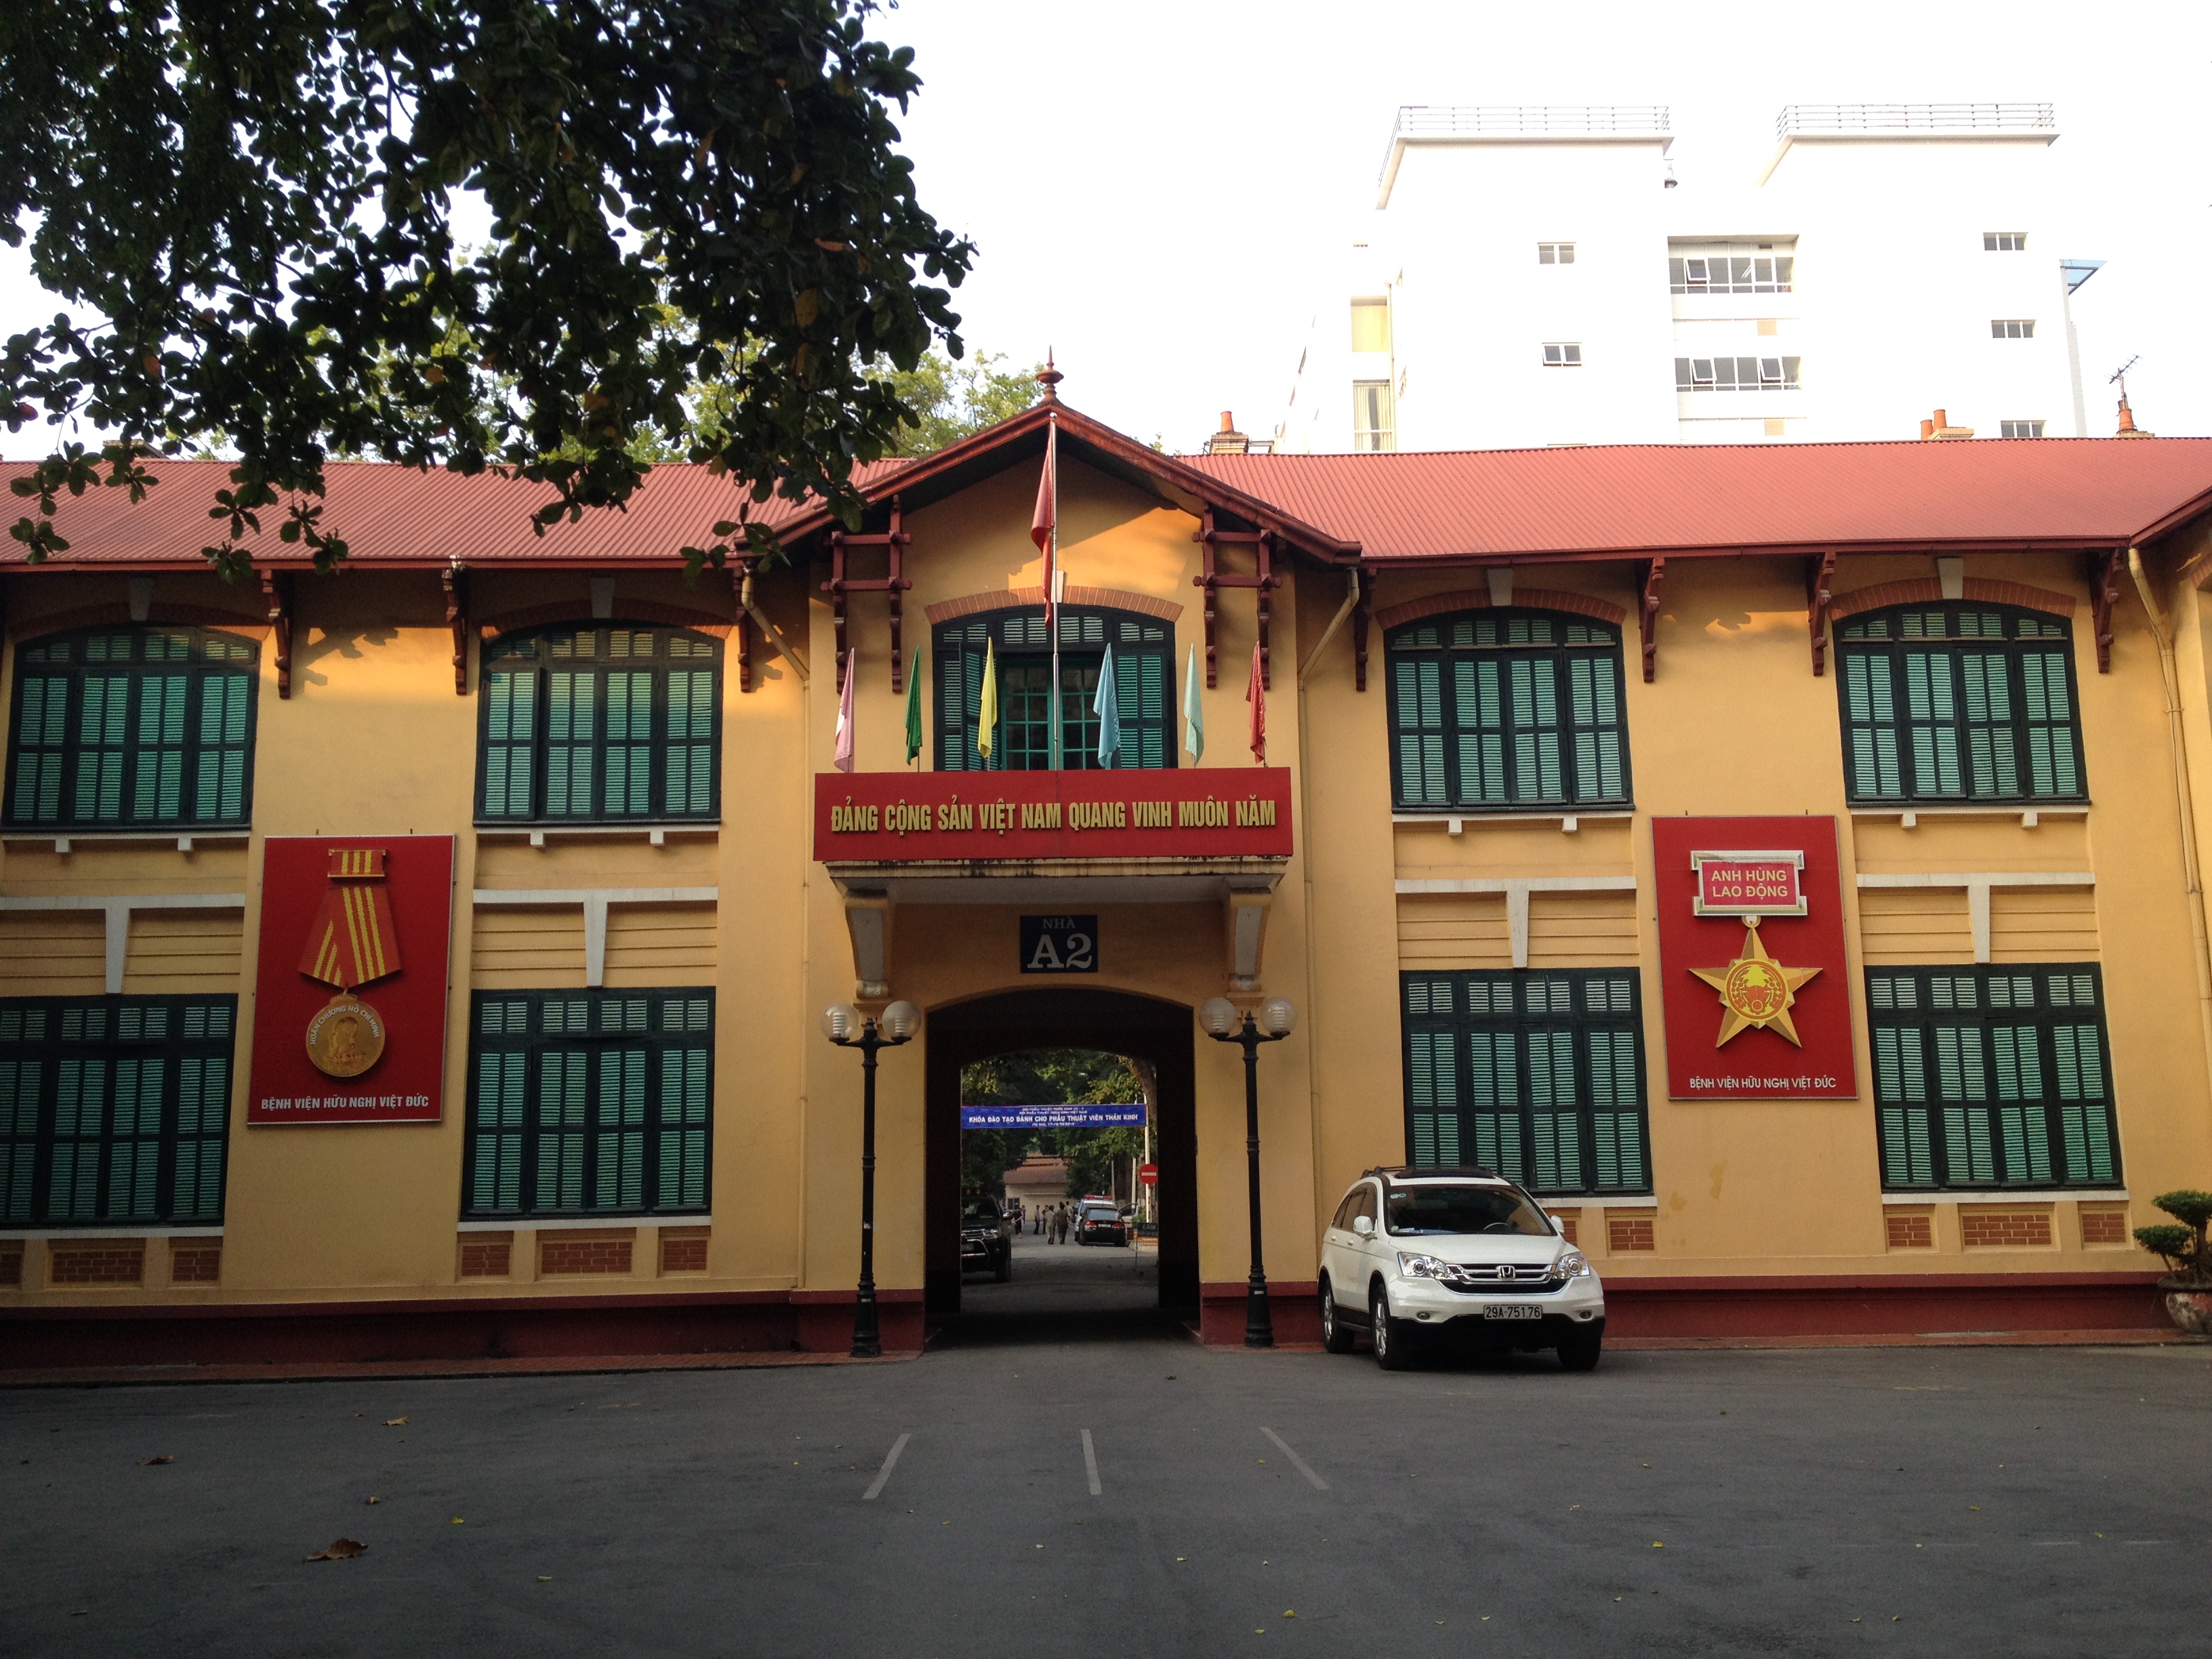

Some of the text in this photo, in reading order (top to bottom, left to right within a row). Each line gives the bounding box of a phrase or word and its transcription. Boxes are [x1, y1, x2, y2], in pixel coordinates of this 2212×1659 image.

[831, 794, 1275, 836] ĐẢNG CỘNG SẢN VIỆT NAM QUANG VINH MUÔN NĂM
[1711, 867, 1787, 882] ANH HÙNG
[1712, 883, 1788, 900] LAO ĐỘNG
[1042, 916, 1076, 929] NHÀ
[1027, 933, 1092, 969] A2
[310, 1024, 321, 1044] HUÂN
[348, 1003, 359, 1013] HỒ
[369, 1019, 380, 1038] MINH
[1689, 1075, 1837, 1090] BỆNH VIỆN HỮU NGHỊ VIỆT ĐỨC
[261, 1092, 429, 1111] BỆNH VIỆN HỮU NGHỊ VIỆT ĐỨC
